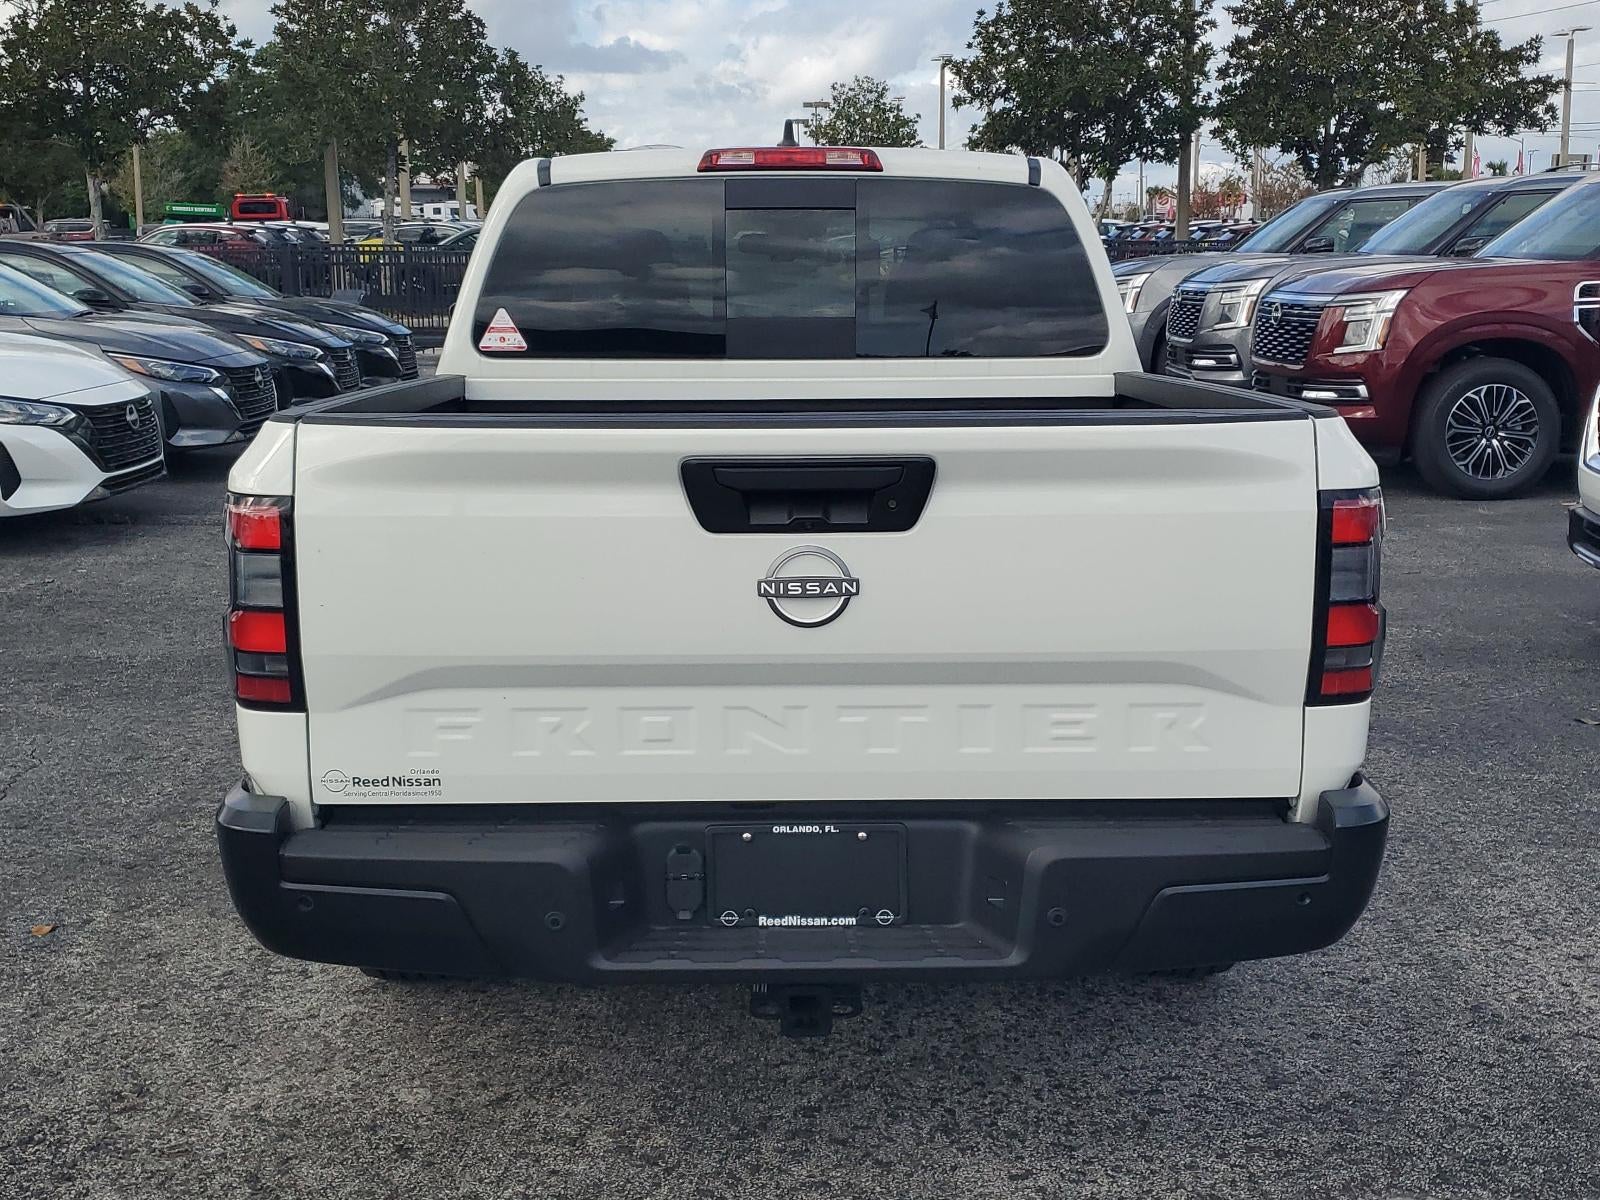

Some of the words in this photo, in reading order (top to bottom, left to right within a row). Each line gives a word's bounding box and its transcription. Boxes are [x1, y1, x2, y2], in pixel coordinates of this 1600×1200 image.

[760, 582, 857, 595] NISSAN
[404, 702, 1211, 757] FRONTIER
[352, 776, 390, 787] Reed
[392, 775, 441, 787] Nissan
[772, 825, 823, 834] ORLANDO,
[824, 825, 840, 833] FL.
[758, 915, 857, 926] ReedNissan.com
